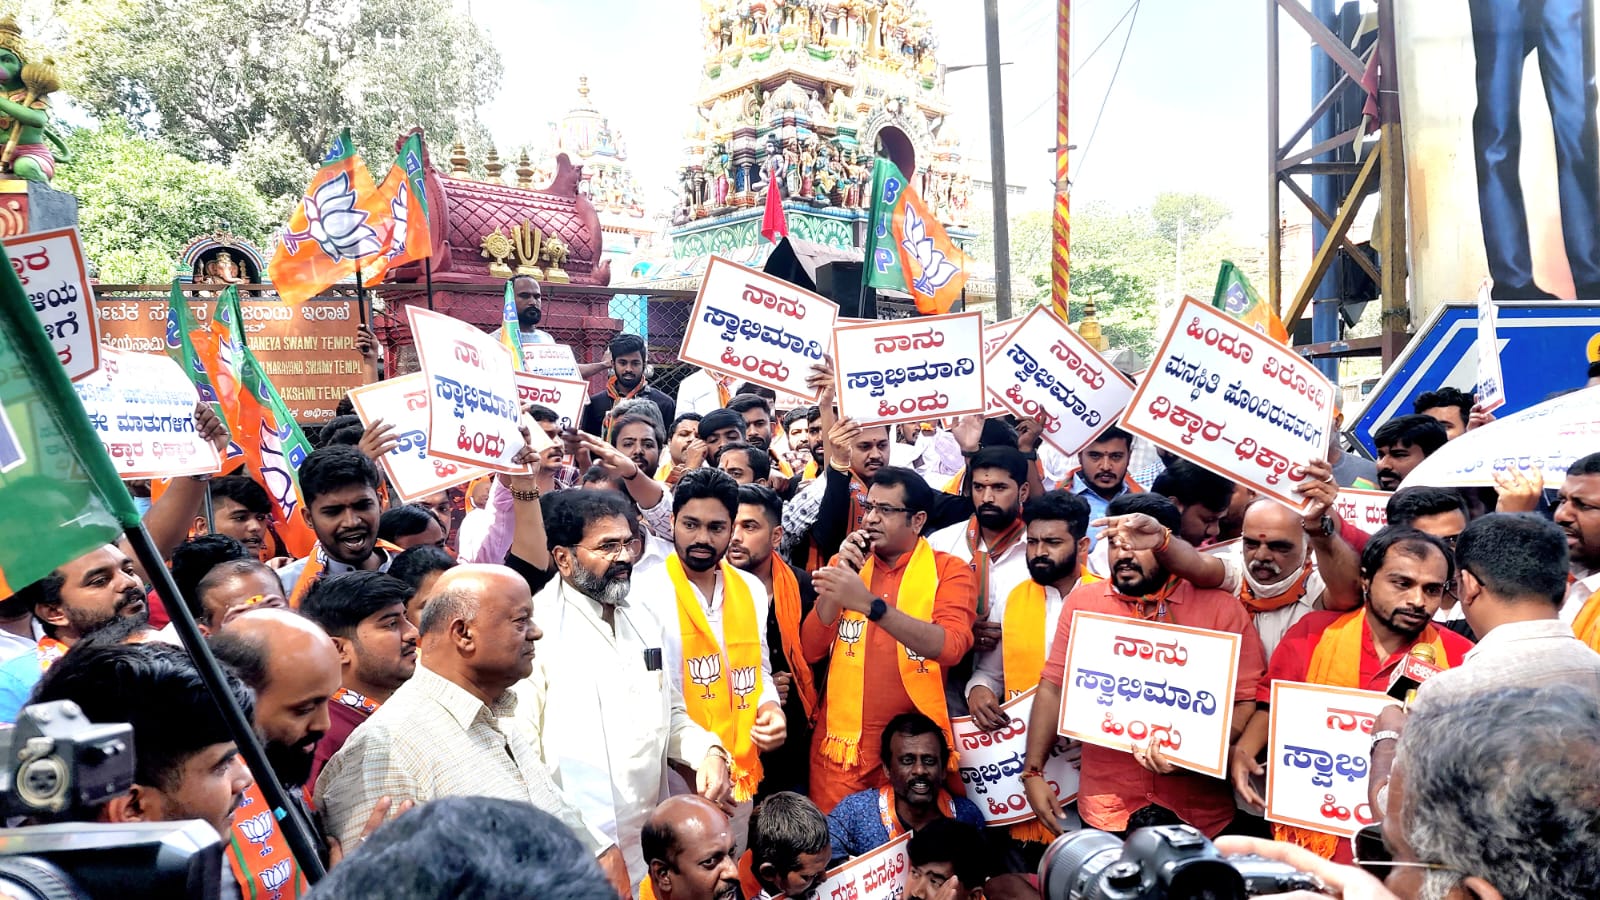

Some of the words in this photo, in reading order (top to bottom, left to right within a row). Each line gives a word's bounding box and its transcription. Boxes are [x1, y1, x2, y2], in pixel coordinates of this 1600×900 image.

[301, 302, 350, 321] ಇಲಾಖೆ
[742, 283, 806, 320] ನಾನು
[284, 336, 318, 351] SWAMY
[321, 336, 357, 351] TEMPL
[703, 305, 823, 360] ಸ್ವಾಭಿಮಾನಿ
[874, 327, 945, 354] ನಾನು
[266, 360, 304, 375] NARAYANA
[306, 360, 333, 374] SWAMY
[335, 360, 363, 374] TEMPL
[720, 346, 790, 382] ಹಿಂದು
[846, 358, 975, 398] ಸ್ವಾಭಿಮಾನಿ
[1049, 339, 1106, 391] ನಾನು
[1186, 316, 1254, 364] ಹಿಂದೂ
[1262, 356, 1326, 411] ವಿರೋಧಿ
[280, 386, 316, 401] AKSHMI
[434, 374, 519, 423] ಸ್ವಾಭಿಮಾನಿ
[877, 390, 949, 417] ಹಿಂದು
[1006, 343, 1102, 428] ಸ್ವಾಭಿಮಾನಿ
[1165, 352, 1221, 402] ಮನಸ್ಥಿತಿ
[1224, 380, 1323, 448] ಹೊಂದಿರುವವರಿಗೆ
[116, 411, 195, 433] ಮಾತುಗಳಿಗೆ
[1005, 384, 1062, 433] ಹಿಂದು
[456, 424, 506, 459] ಹಿಂದು
[1113, 635, 1188, 667] ನಾನು
[1075, 667, 1217, 716] ಸ್ವಾಭಿಮಾನಿ
[1100, 711, 1183, 751] ಹಿಂದು
